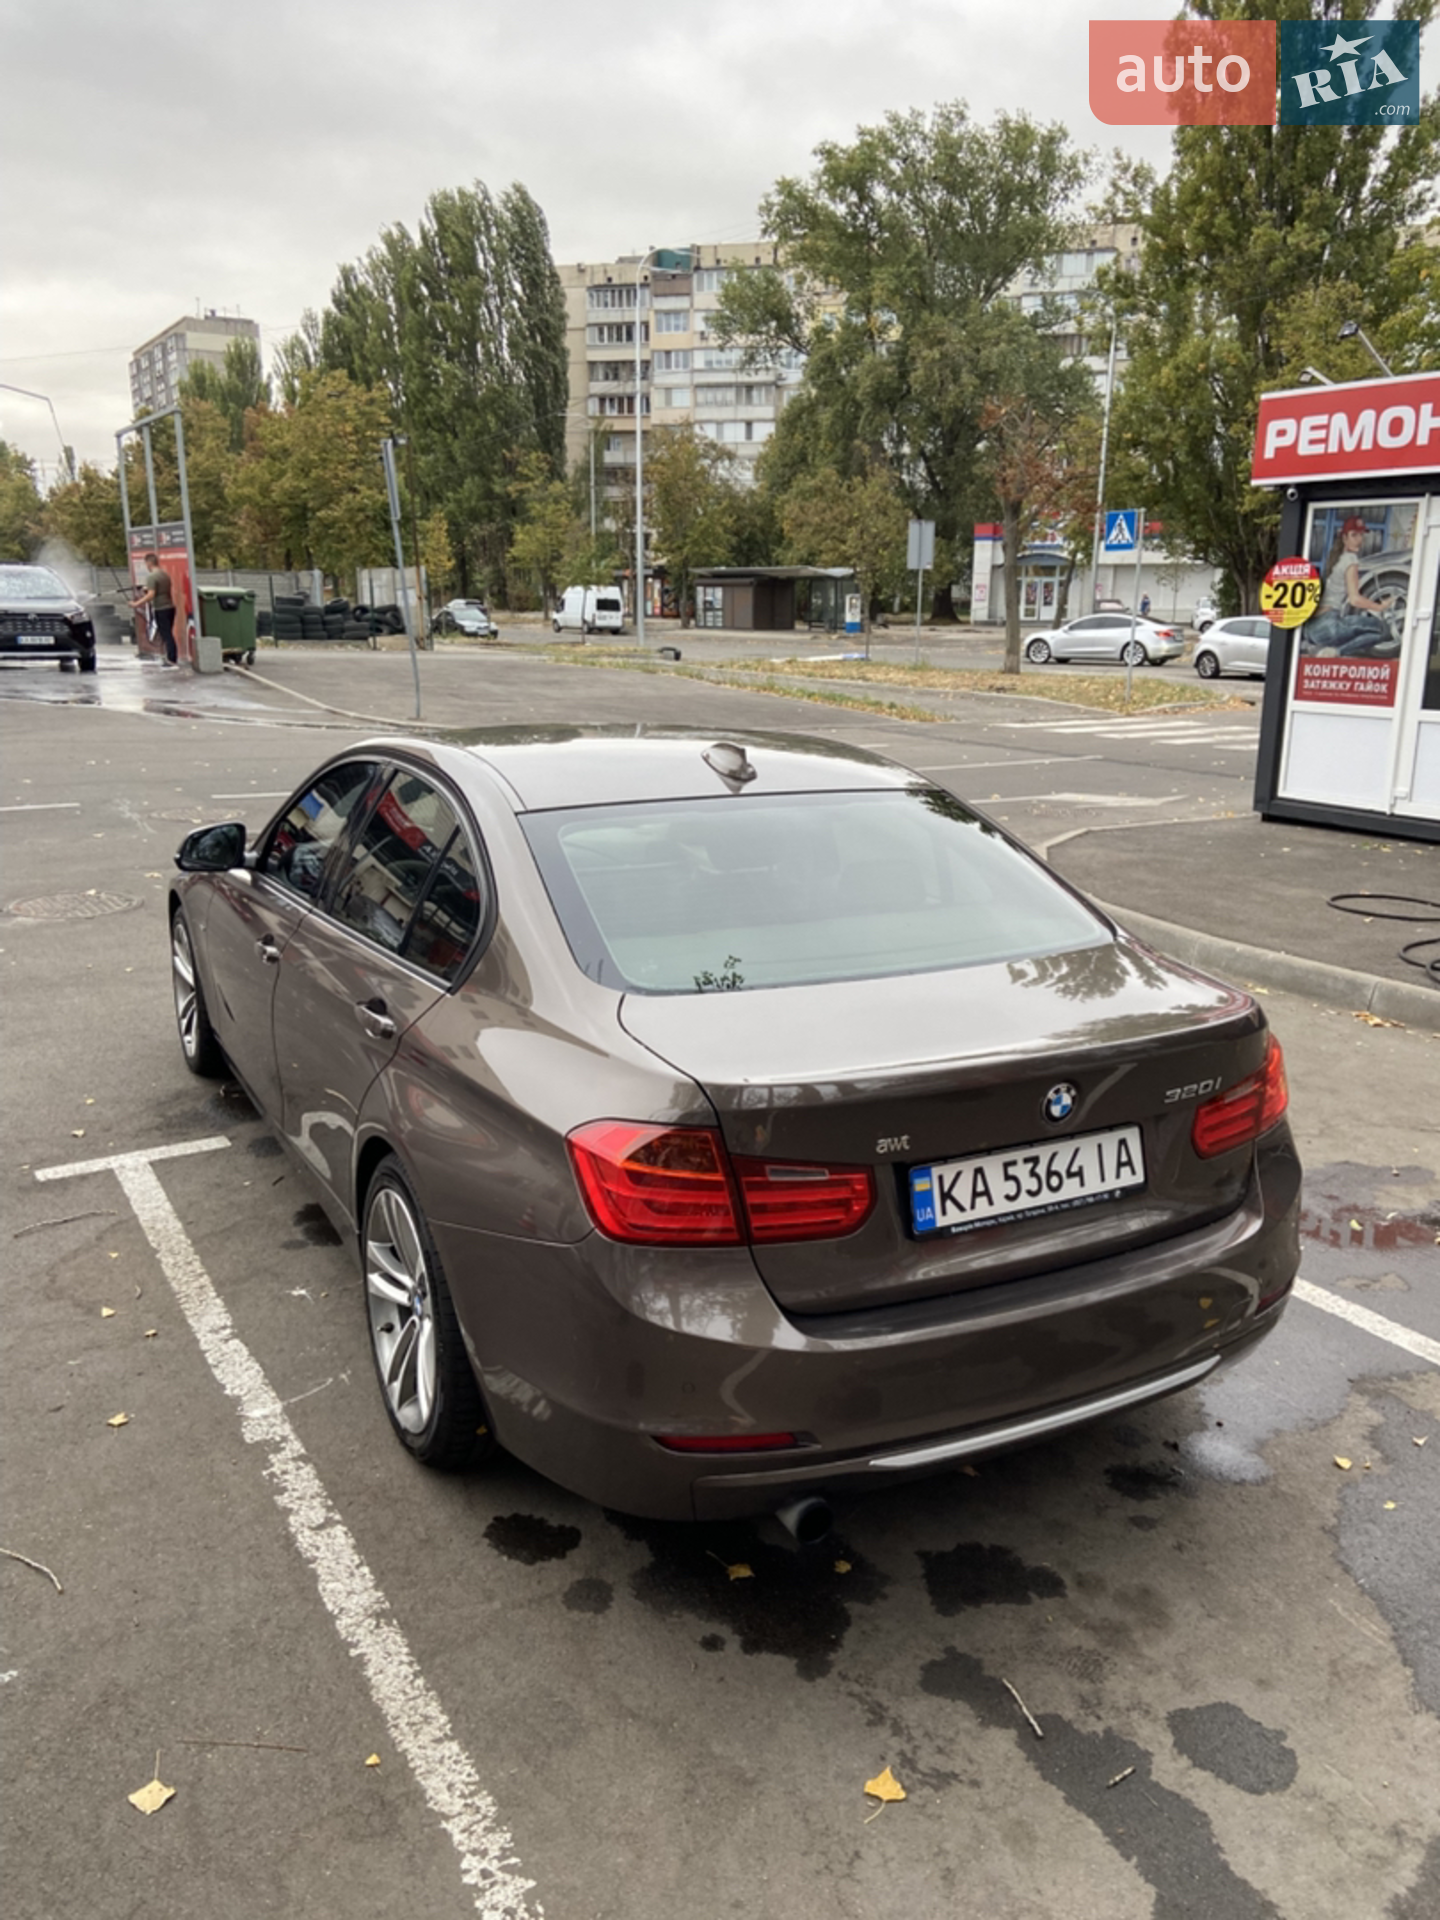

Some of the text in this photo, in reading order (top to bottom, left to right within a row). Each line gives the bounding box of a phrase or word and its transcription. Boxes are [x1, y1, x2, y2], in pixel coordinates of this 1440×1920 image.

[1265, 582, 1321, 609] -20%
[1303, 664, 1390, 680] КОНТРОЛЮЙ
[1303, 679, 1388, 694] ЗАТЯЖКУ ГАЙОК
[1002, 1146, 1085, 1202] 5364
[917, 1207, 934, 1222] UA
